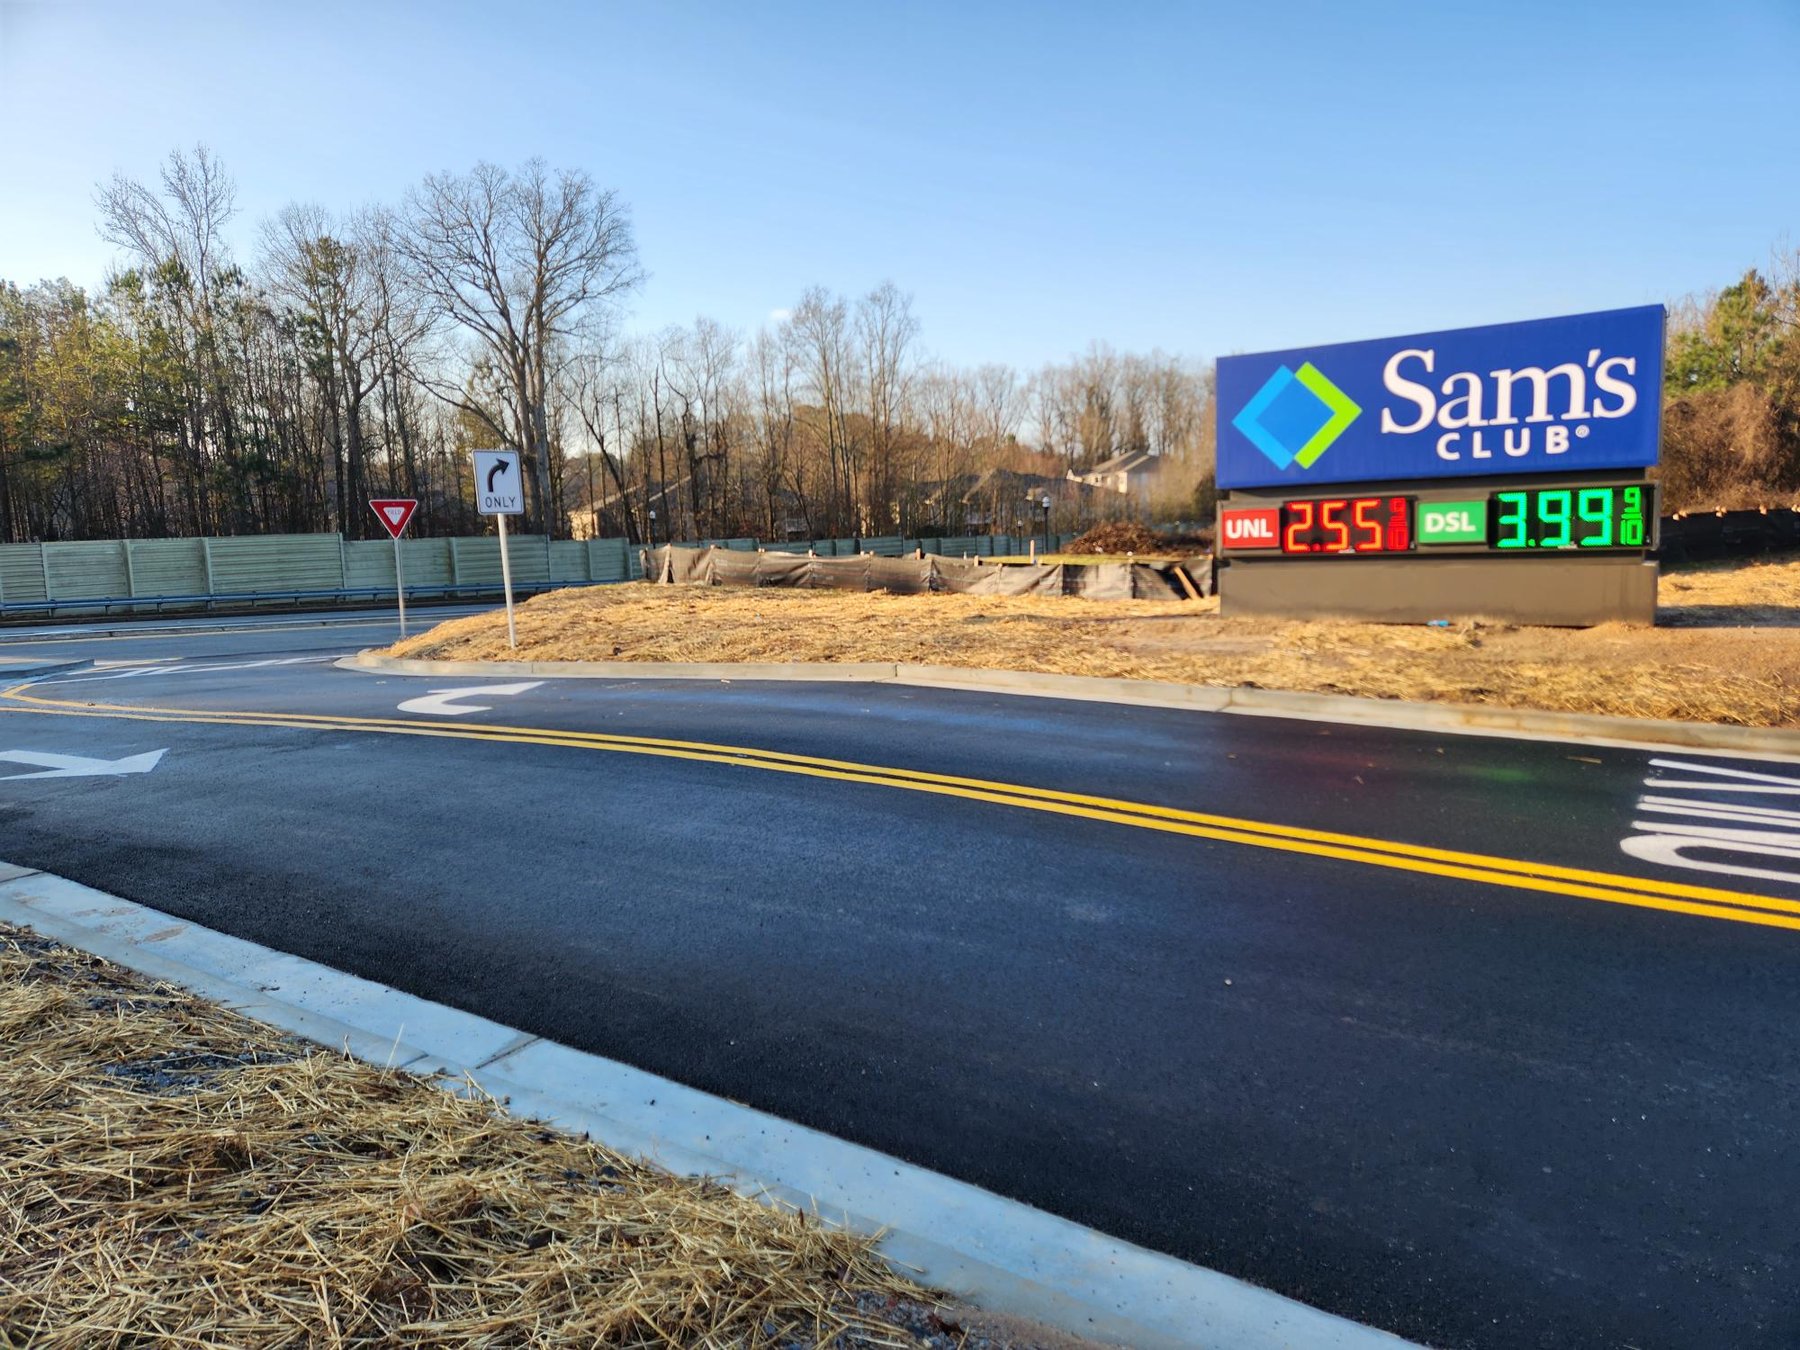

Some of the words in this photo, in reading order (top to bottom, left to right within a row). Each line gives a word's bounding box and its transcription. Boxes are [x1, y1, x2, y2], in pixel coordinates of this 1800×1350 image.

[1381, 349, 1637, 434] Sam's
[1436, 425, 1570, 460] CLUB
[485, 496, 516, 508] ONLY
[1225, 518, 1273, 539] UNL
[1284, 499, 1383, 553] 2.55
[1425, 511, 1476, 533] DSL
[1497, 488, 1613, 548] 3.99
